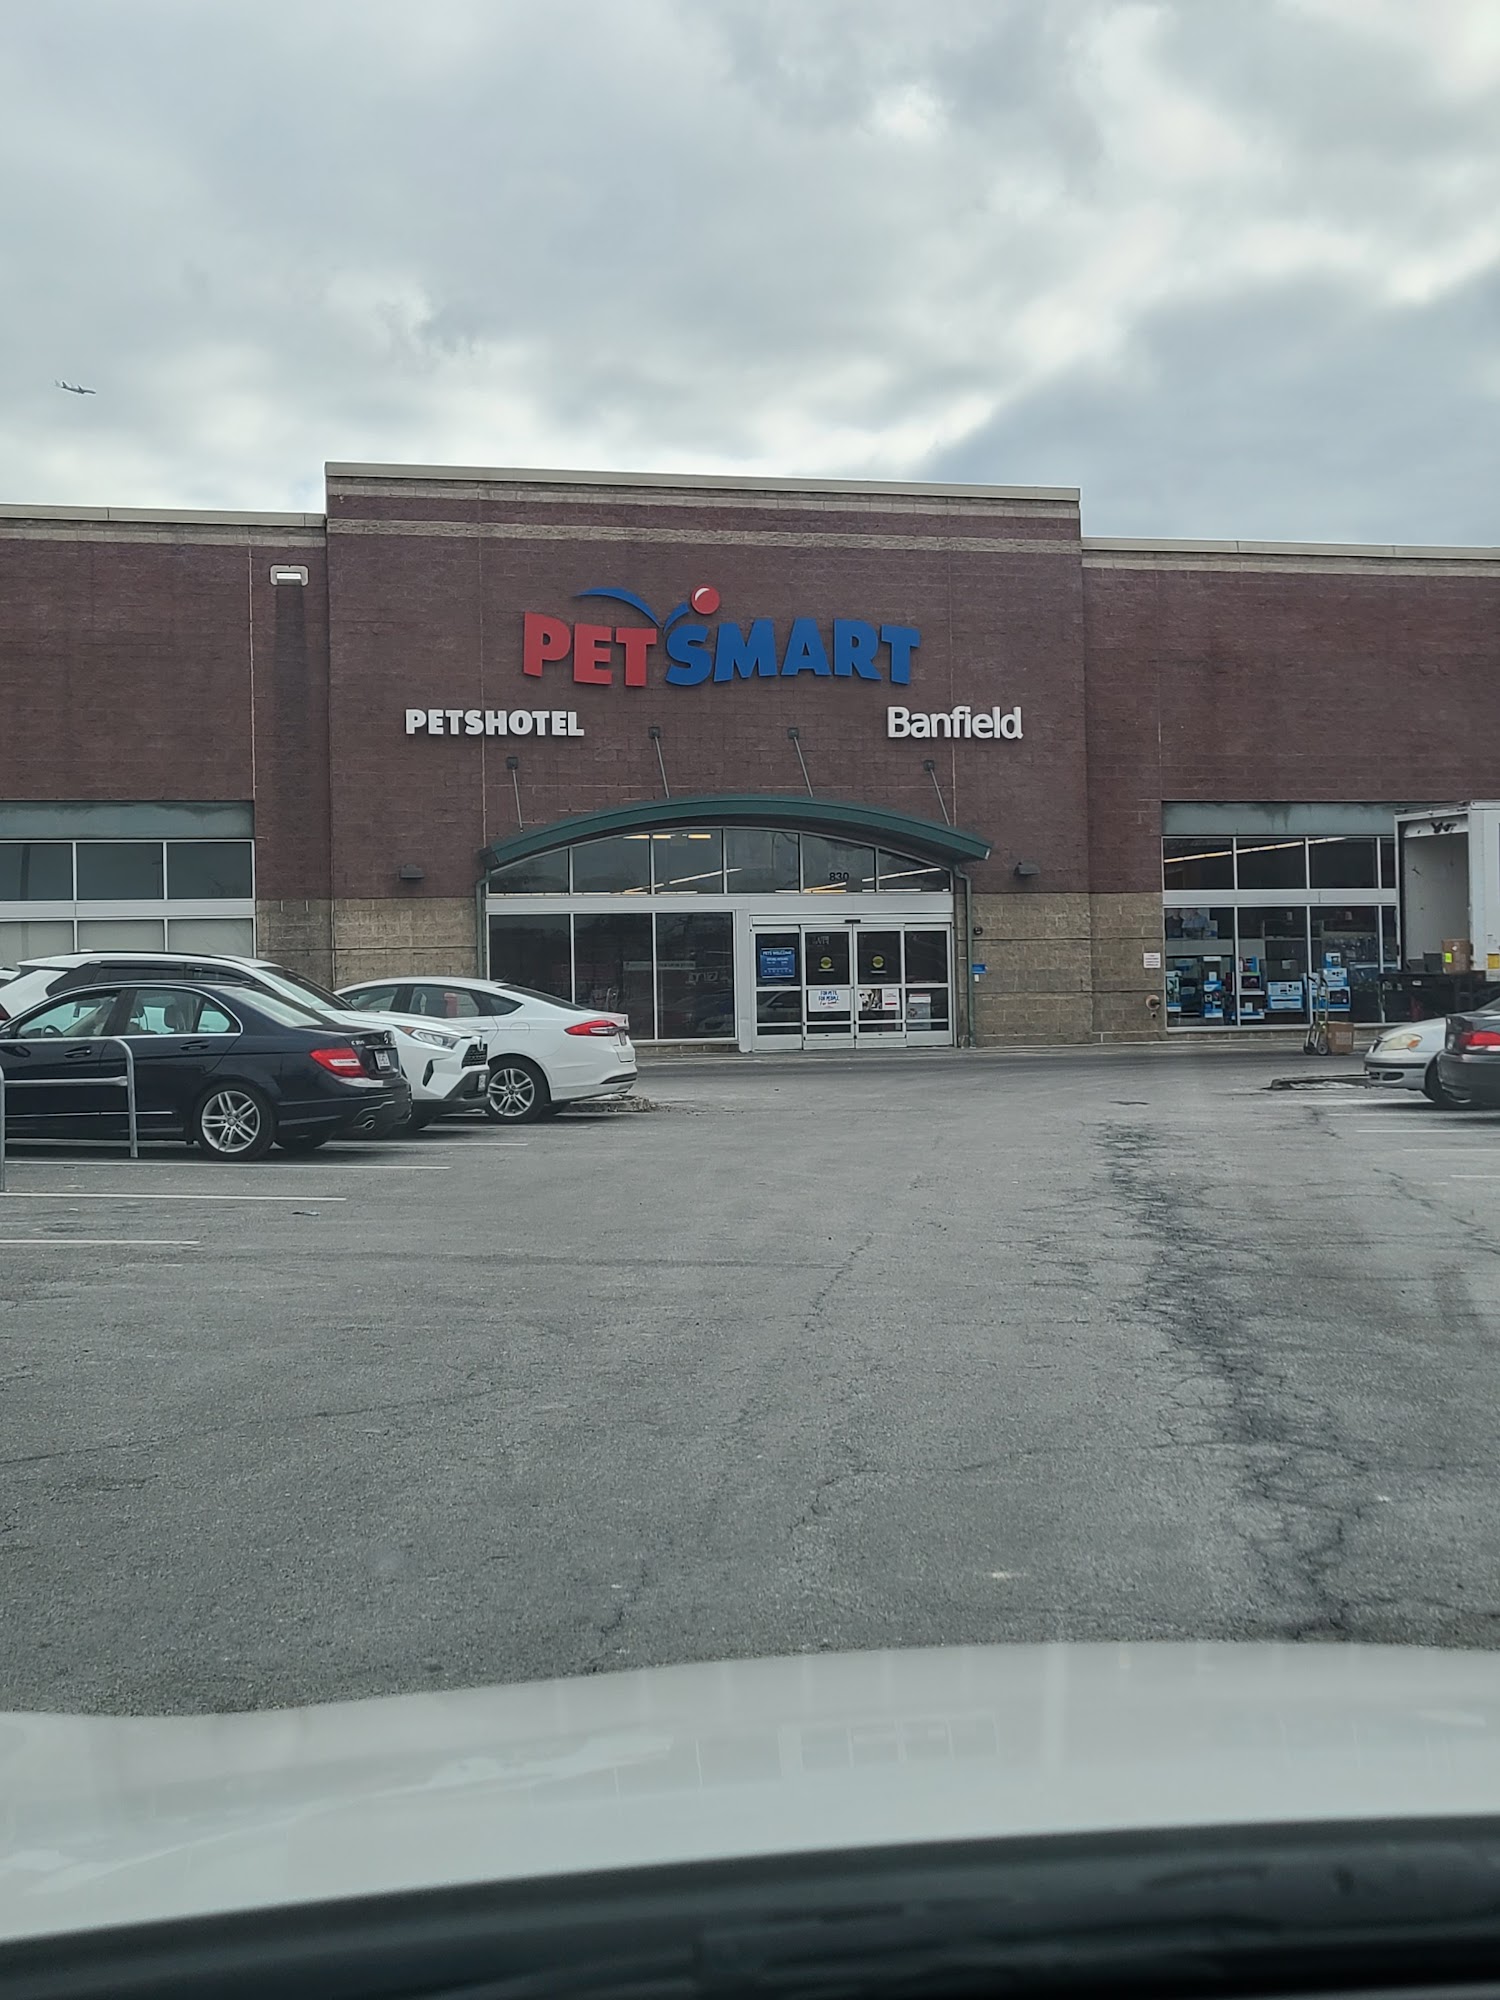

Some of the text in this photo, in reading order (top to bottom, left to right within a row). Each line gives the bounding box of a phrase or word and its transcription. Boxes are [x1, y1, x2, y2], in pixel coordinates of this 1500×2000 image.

[405, 708, 585, 737] PETSHOTEL
[887, 705, 1024, 740] Banfield
[829, 871, 850, 882] 830
